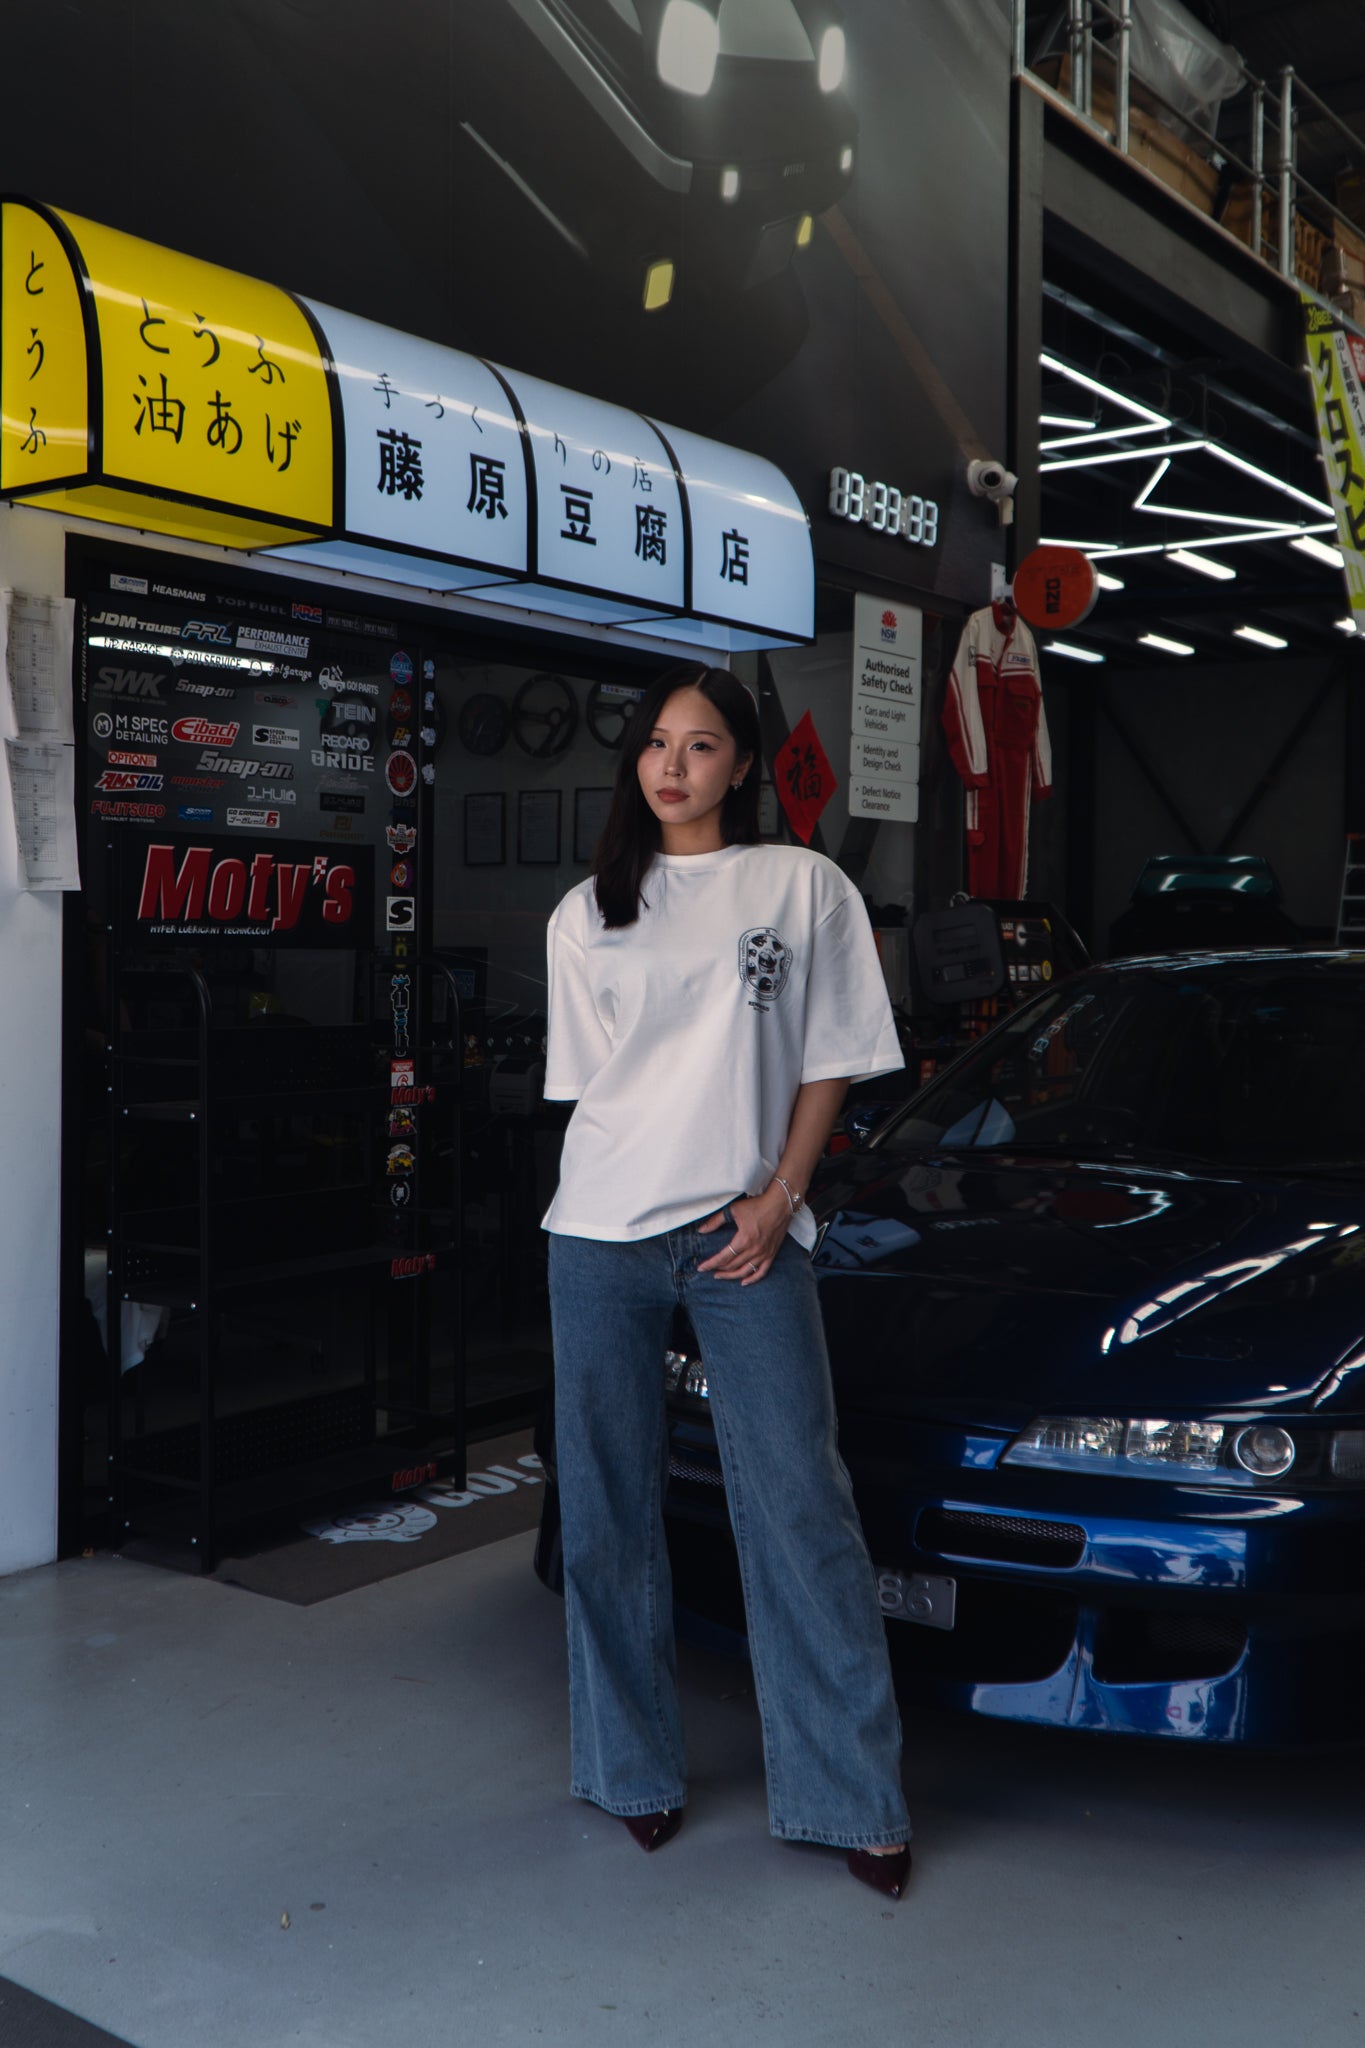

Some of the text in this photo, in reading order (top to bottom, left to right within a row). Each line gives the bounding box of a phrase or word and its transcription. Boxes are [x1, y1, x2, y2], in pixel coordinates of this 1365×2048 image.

[138, 297, 286, 385] とうふ
[19, 250, 47, 455] とうふ
[132, 373, 302, 472] 油あげ
[376, 428, 751, 586] 藤原豆腐店
[152, 584, 206, 602] HEASMANS
[249, 603, 287, 616] FUEL
[90, 611, 182, 636] JDM TOURS
[181, 620, 233, 646] PRL
[238, 625, 311, 648] PERFORMANCE
[880, 628, 897, 640] NSW
[865, 658, 910, 679] Authorised
[94, 666, 167, 697] SWK
[175, 678, 236, 699] Snap-on
[358, 683, 380, 696] PARTS
[861, 674, 914, 696] Safety Check
[331, 702, 377, 722] TEIN
[864, 705, 907, 723] Cars and Light
[115, 714, 168, 734] M SPEC
[173, 718, 237, 738] Eibach
[864, 718, 889, 732] Vehicles
[115, 730, 169, 745] DETAILING
[321, 734, 370, 751] RECARO
[109, 752, 148, 767] OPTION
[311, 750, 375, 772] BRIDE
[863, 744, 900, 760] Identity and
[196, 750, 294, 780] Snap-on
[862, 758, 903, 772] Design Check
[96, 771, 163, 791] AMSOIL
[862, 785, 902, 800] Defect Notice
[91, 800, 166, 818] FUJITSUBO
[862, 799, 891, 812] Clearance
[137, 844, 356, 932] Moty's
